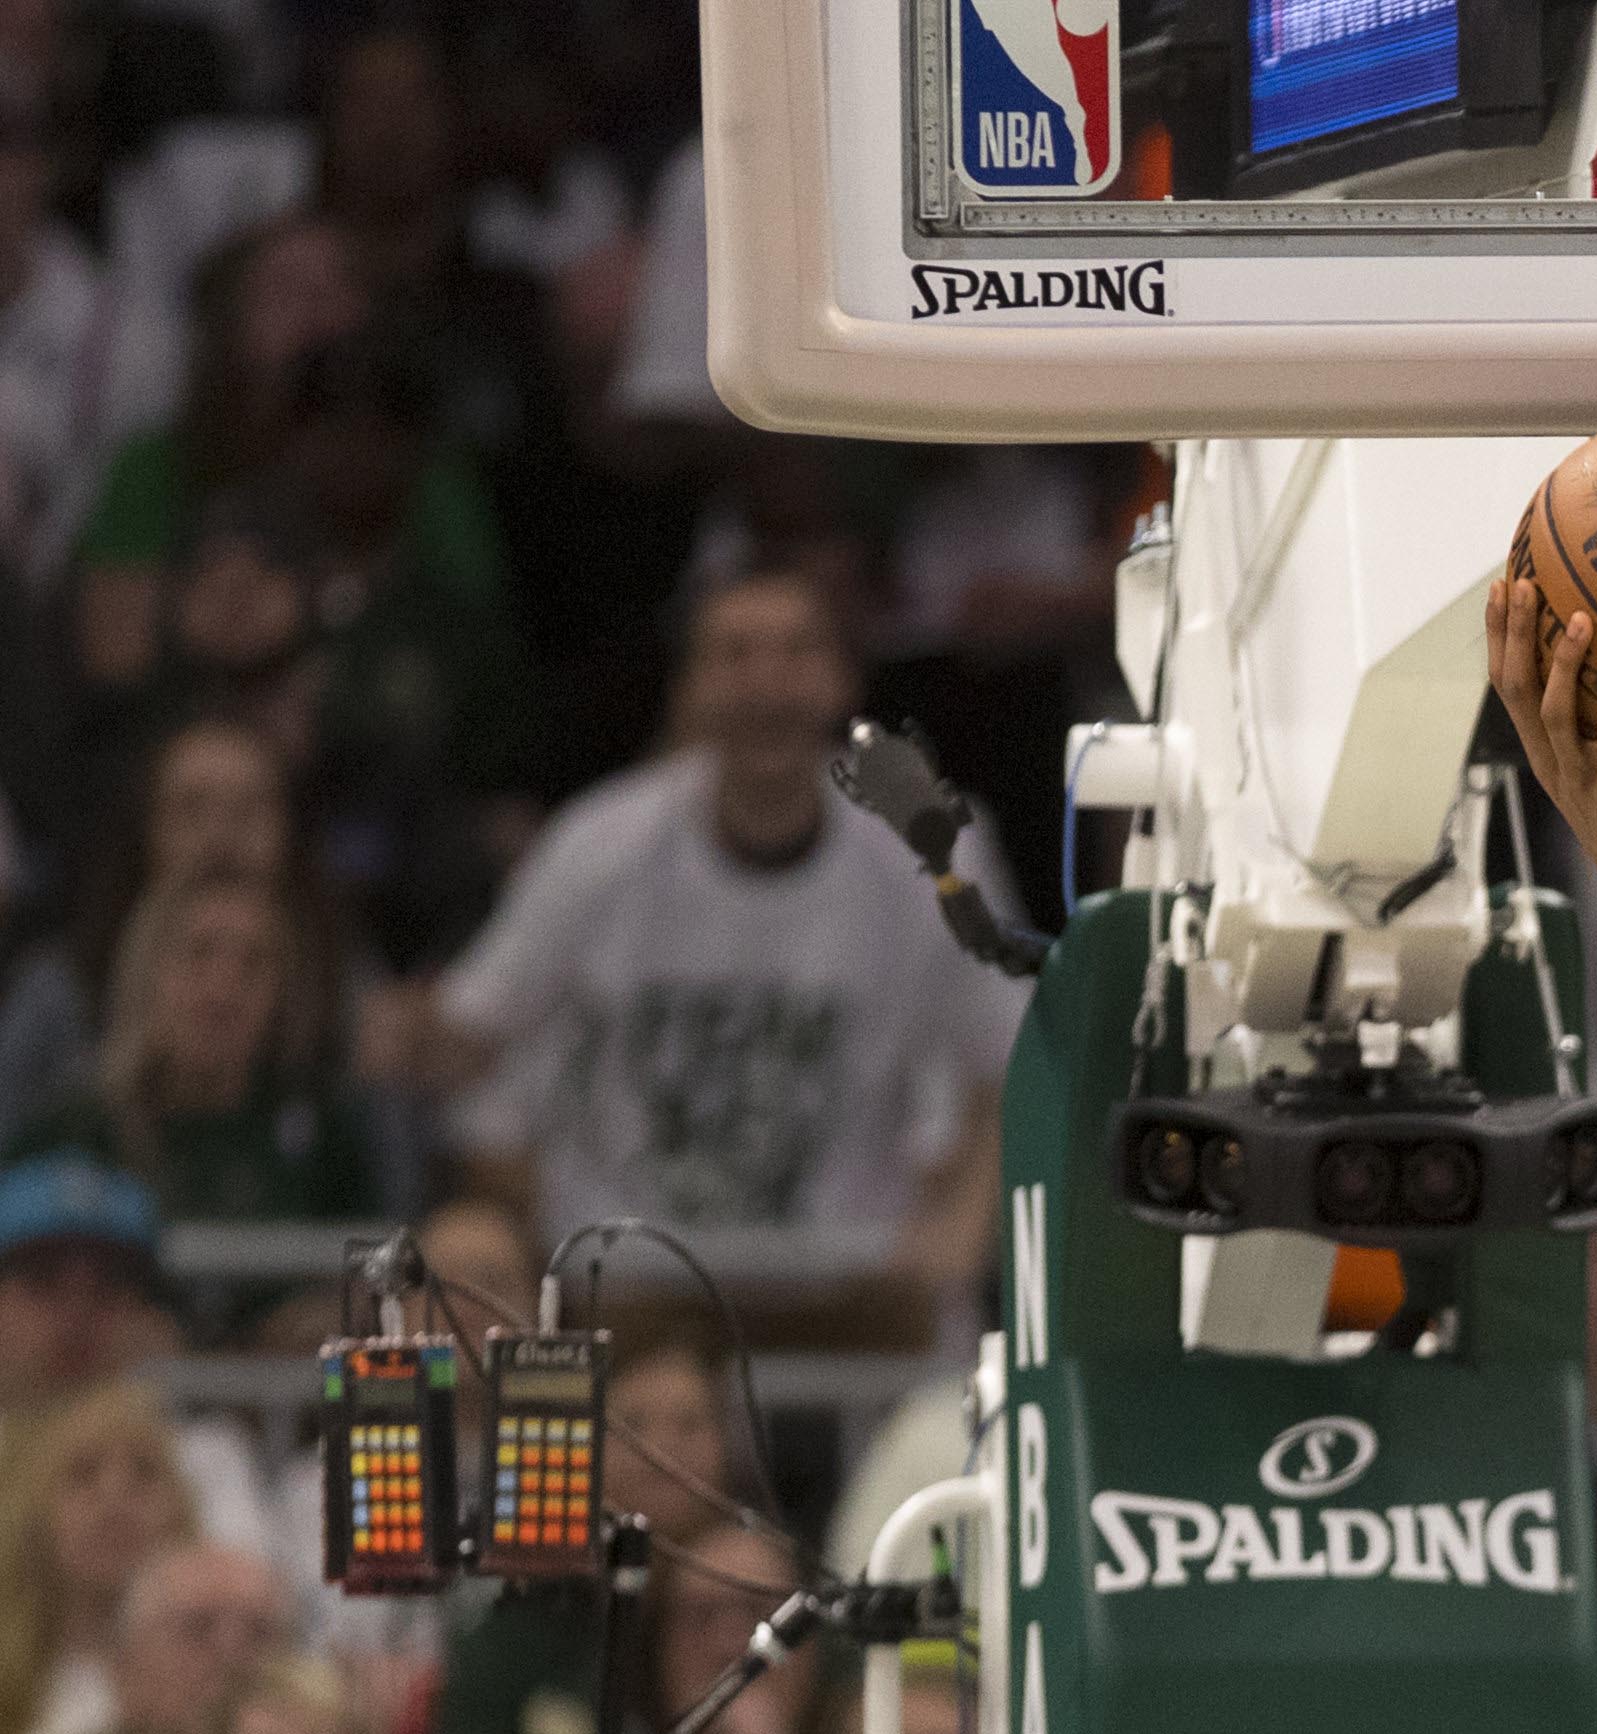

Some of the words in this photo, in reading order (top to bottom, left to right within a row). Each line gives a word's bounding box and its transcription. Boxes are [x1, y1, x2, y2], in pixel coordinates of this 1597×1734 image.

[980, 112, 1055, 168] NBA
[911, 259, 1165, 320] SPALDING
[1090, 1490, 1561, 1593] SPALDING
